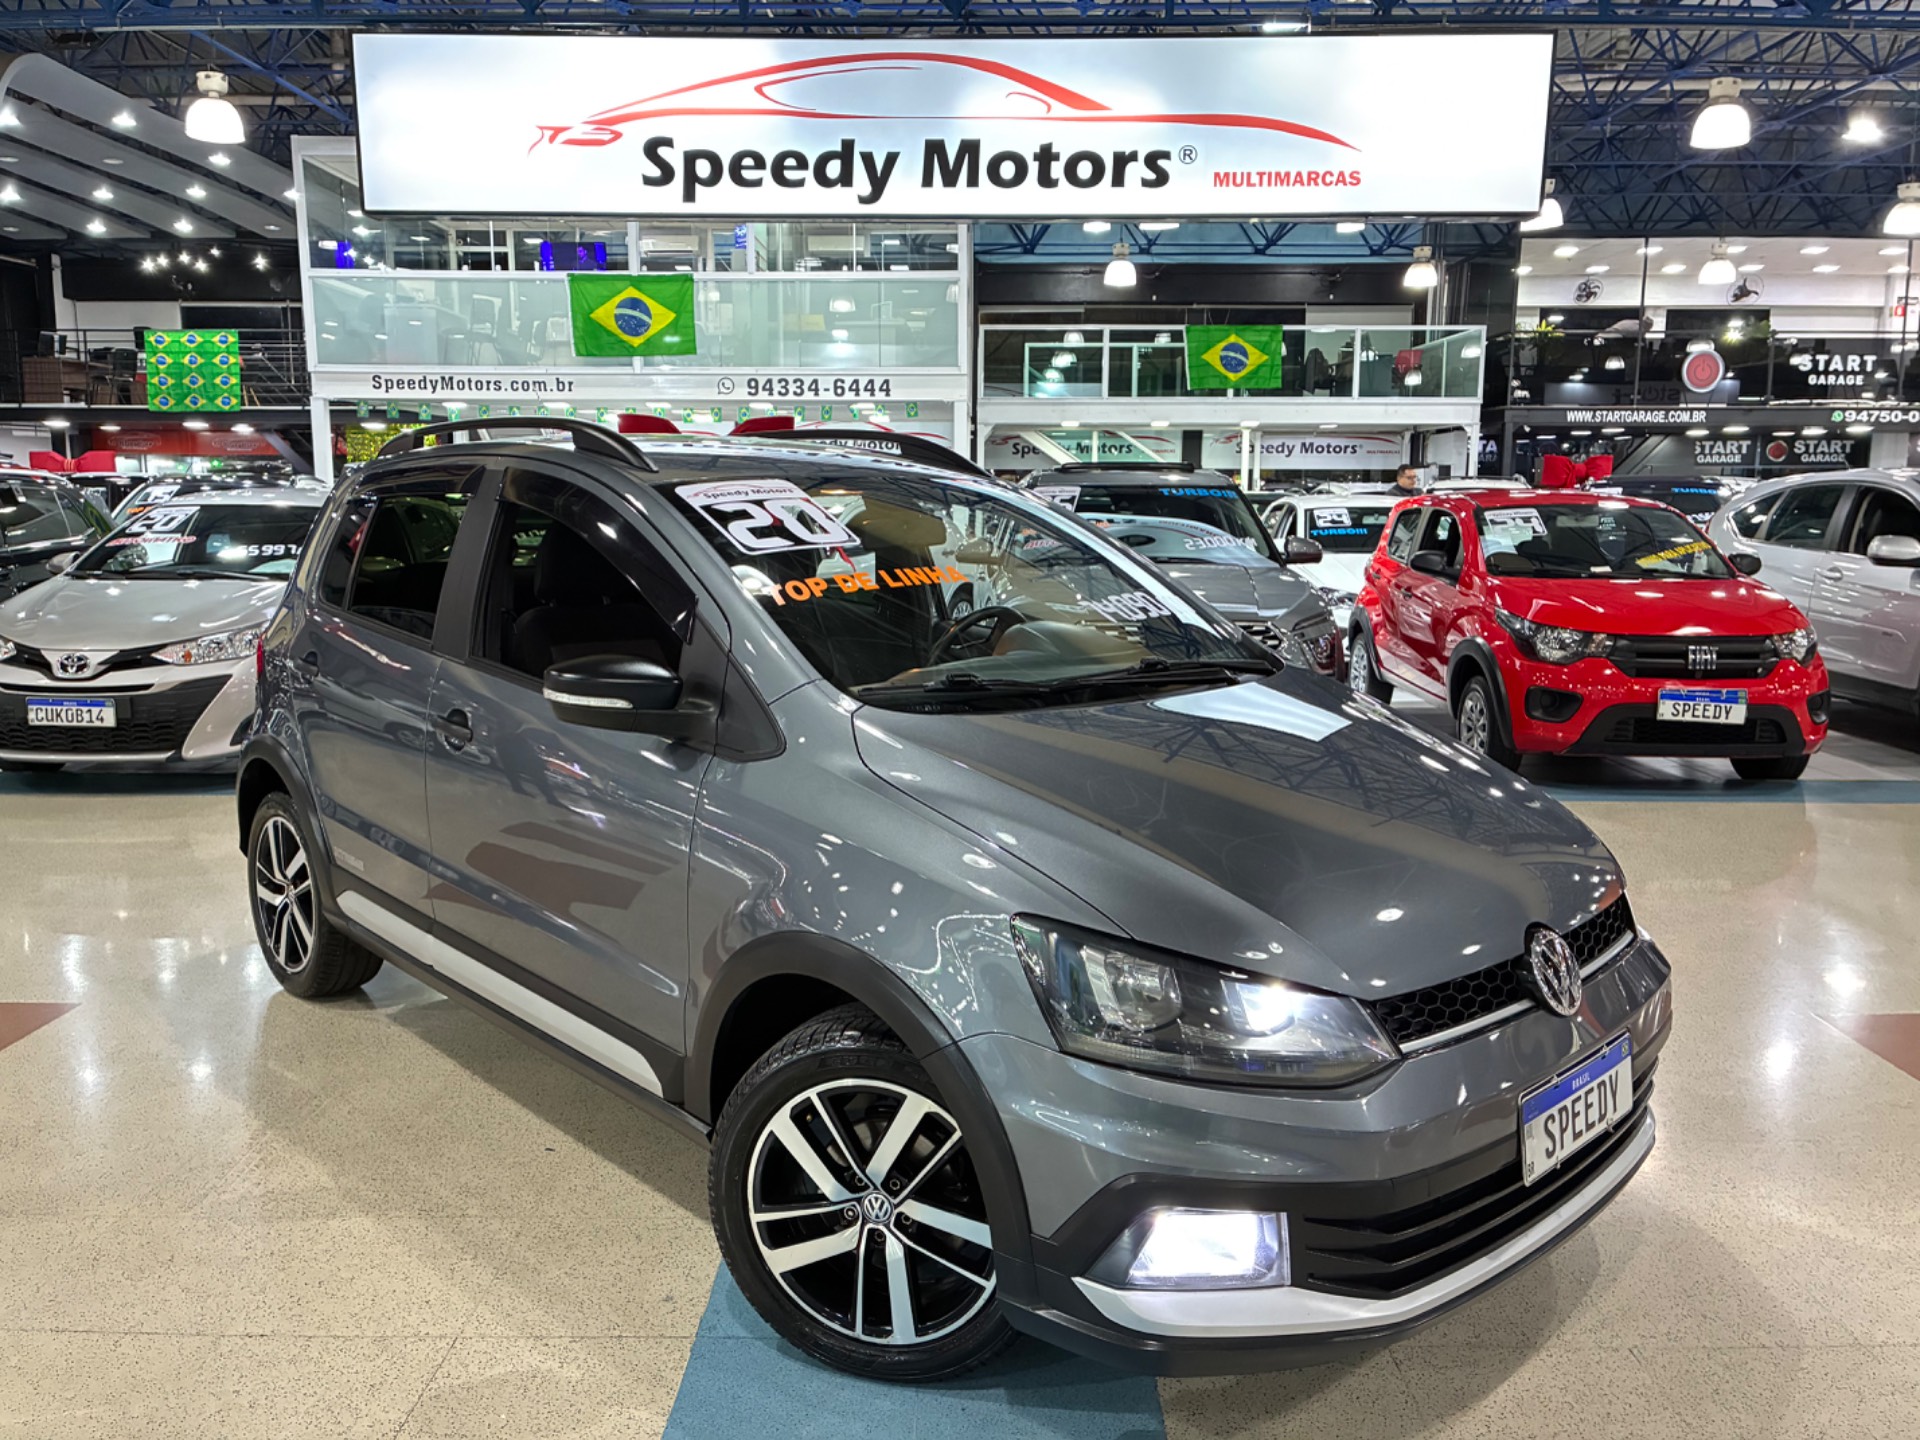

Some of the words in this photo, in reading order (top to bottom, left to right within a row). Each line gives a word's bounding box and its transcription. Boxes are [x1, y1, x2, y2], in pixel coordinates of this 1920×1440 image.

[642, 136, 900, 205] Speedy
[1213, 171, 1361, 187] MULTIMARCAS
[1798, 355, 1877, 371] START
[372, 375, 574, 394] SpeedyMotors.com.br
[747, 378, 891, 397] 94334-6444
[1808, 375, 1864, 385] GARAGE
[1566, 410, 1706, 423] WWW.STARTGARAGE.COM.BR
[1794, 440, 1855, 454] START
[1696, 455, 1742, 464] GARAGE
[1801, 454, 1845, 463] GARAGE
[709, 499, 852, 548] 20
[766, 580, 828, 606] TOP
[832, 571, 881, 594] DE
[878, 565, 970, 588] LINHA
[1687, 645, 1719, 670] FIAT
[1671, 702, 1733, 721] SPEEDY
[1572, 1072, 1591, 1091] BRASIL
[1543, 1069, 1619, 1159] SPEEDY
